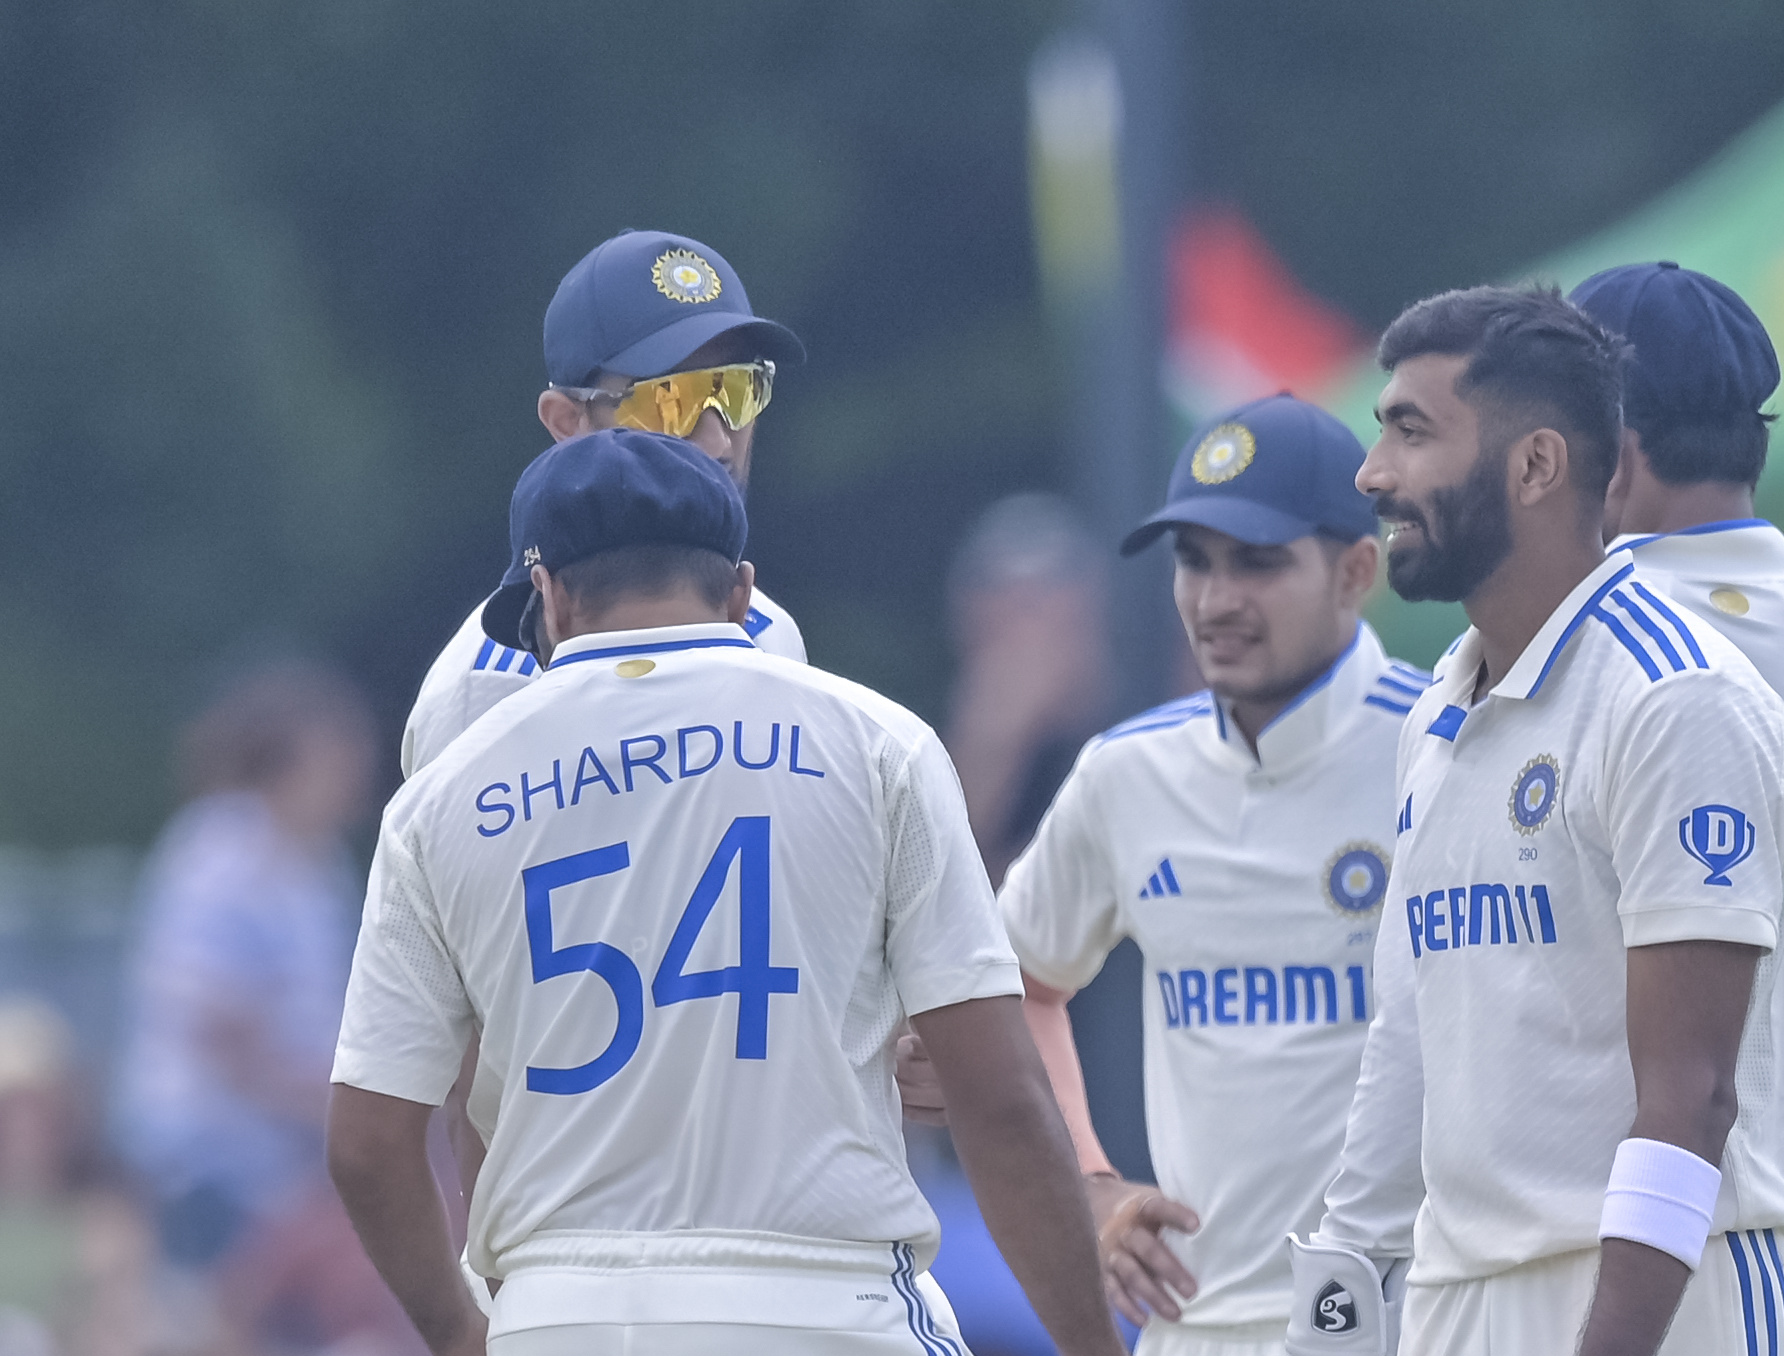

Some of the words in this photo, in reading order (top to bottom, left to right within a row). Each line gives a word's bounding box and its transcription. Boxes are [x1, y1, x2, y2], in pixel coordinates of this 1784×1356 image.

[475, 720, 826, 838] SHARDUL
[1518, 847, 1538, 861] 290
[521, 815, 799, 1096] 54
[1156, 964, 1374, 1031] DREAM1
